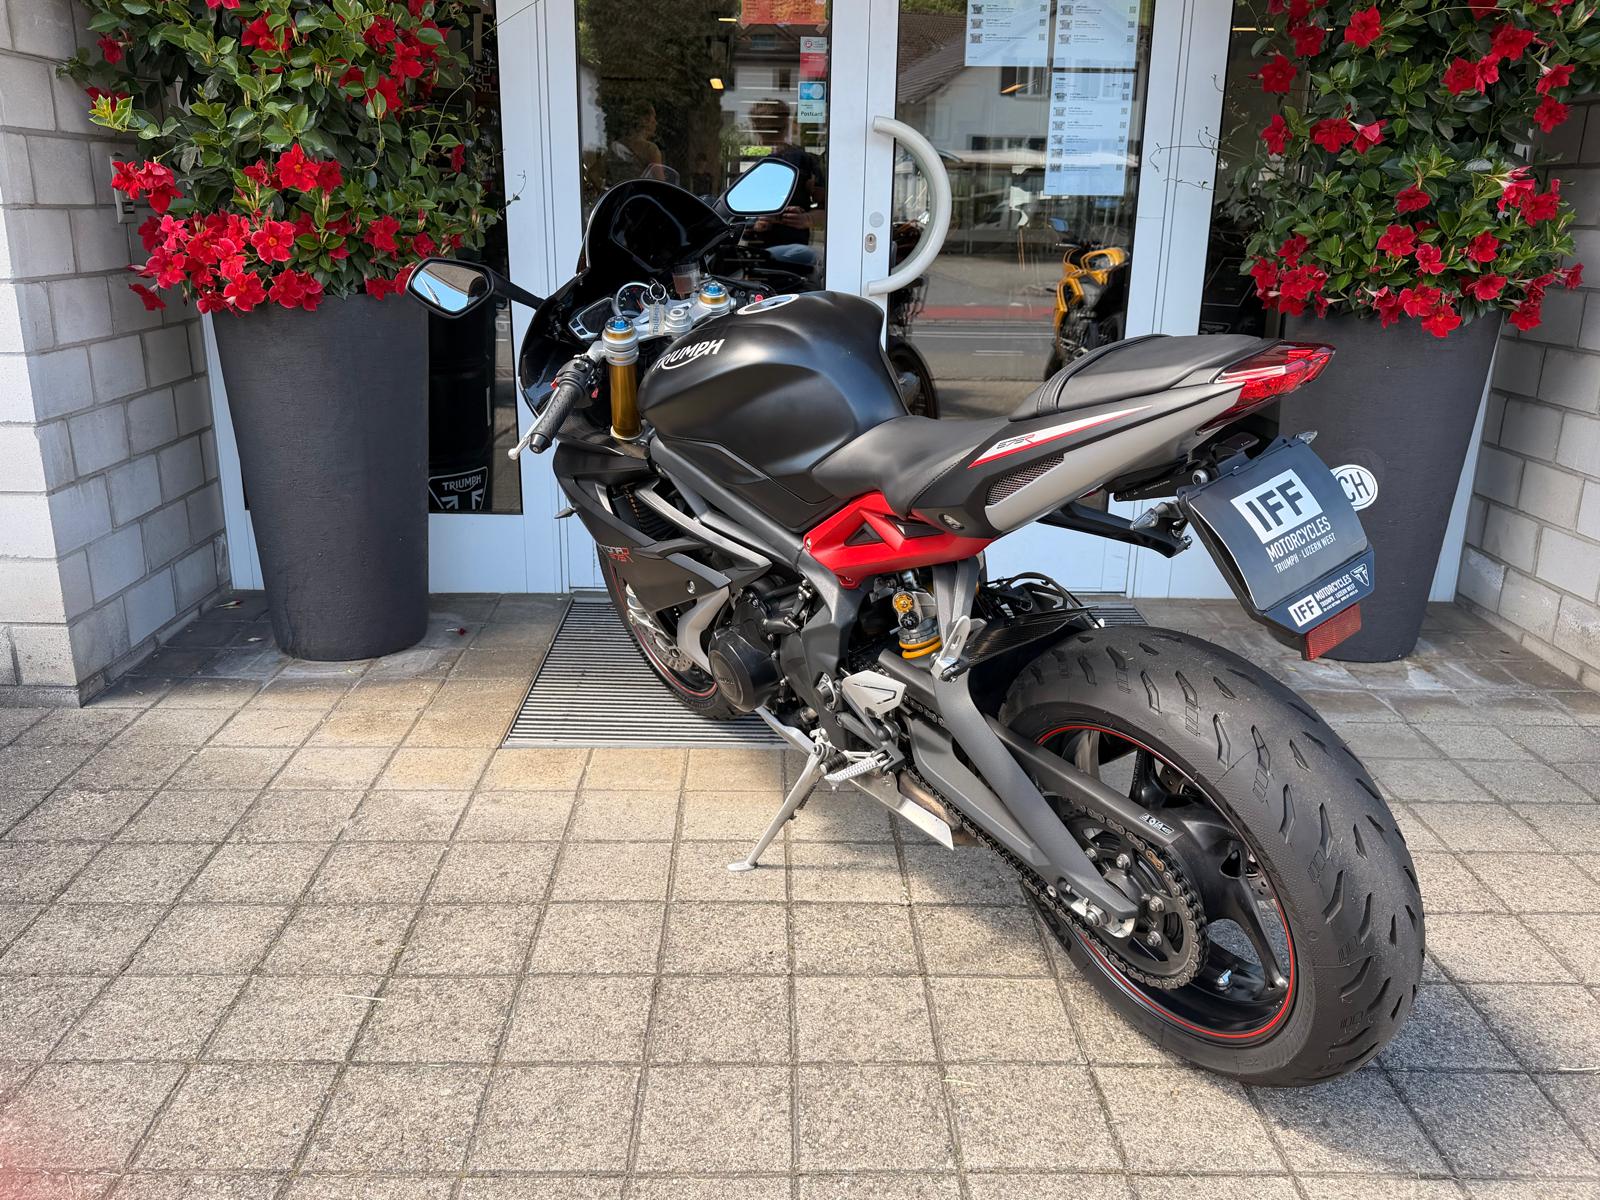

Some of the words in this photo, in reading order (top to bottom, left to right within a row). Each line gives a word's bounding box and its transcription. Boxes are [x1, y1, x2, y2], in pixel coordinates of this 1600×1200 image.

[651, 339, 725, 374] TRIUMPH
[442, 474, 481, 492] TRIUMPH
[1338, 471, 1371, 502] CH
[1245, 479, 1303, 533] IFF
[1265, 515, 1331, 562] MOTORCYCLES
[1273, 553, 1300, 573] TRIUMPH
[1301, 540, 1323, 558] LUZERN
[1320, 532, 1336, 547] WEST
[1313, 573, 1352, 601] MOTORCYCLES
[1293, 599, 1315, 622] IFF
